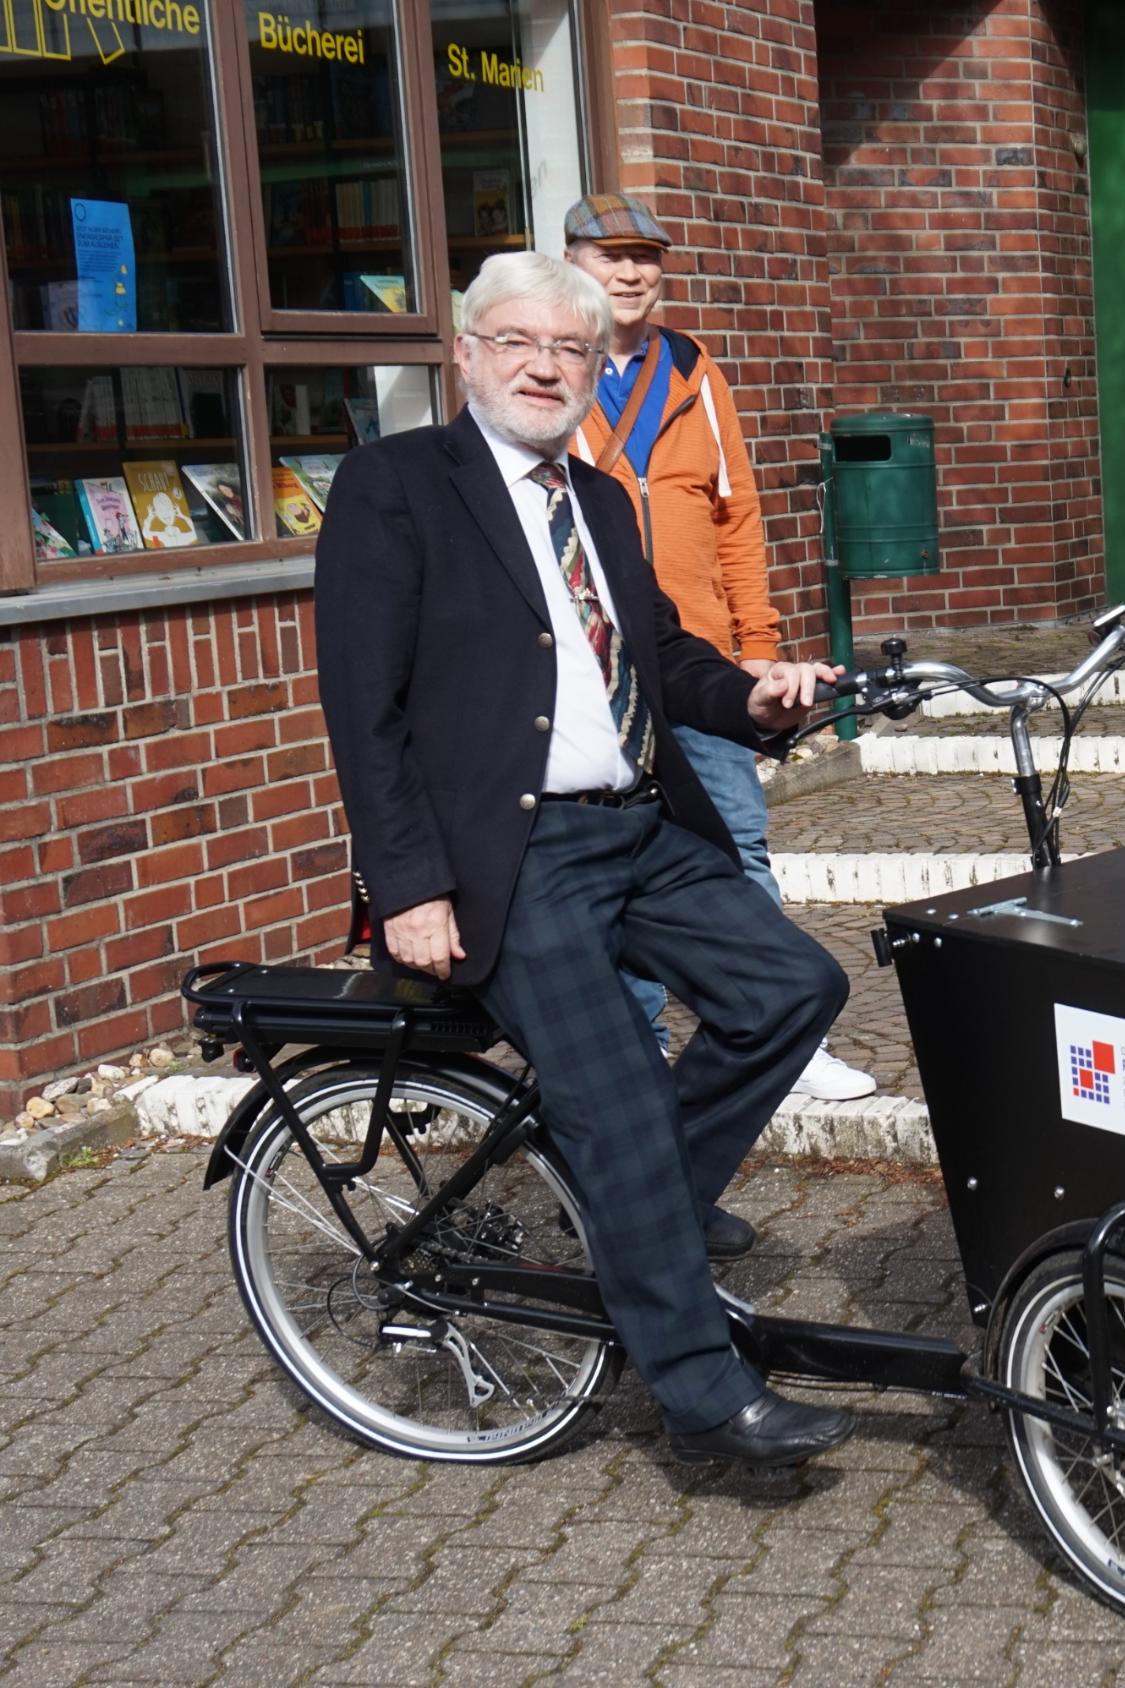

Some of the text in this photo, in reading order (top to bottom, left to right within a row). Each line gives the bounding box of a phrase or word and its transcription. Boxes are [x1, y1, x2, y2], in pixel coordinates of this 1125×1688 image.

[258, 11, 365, 65] Bücherei
[447, 43, 476, 81] St.
[481, 51, 544, 93] Marien
